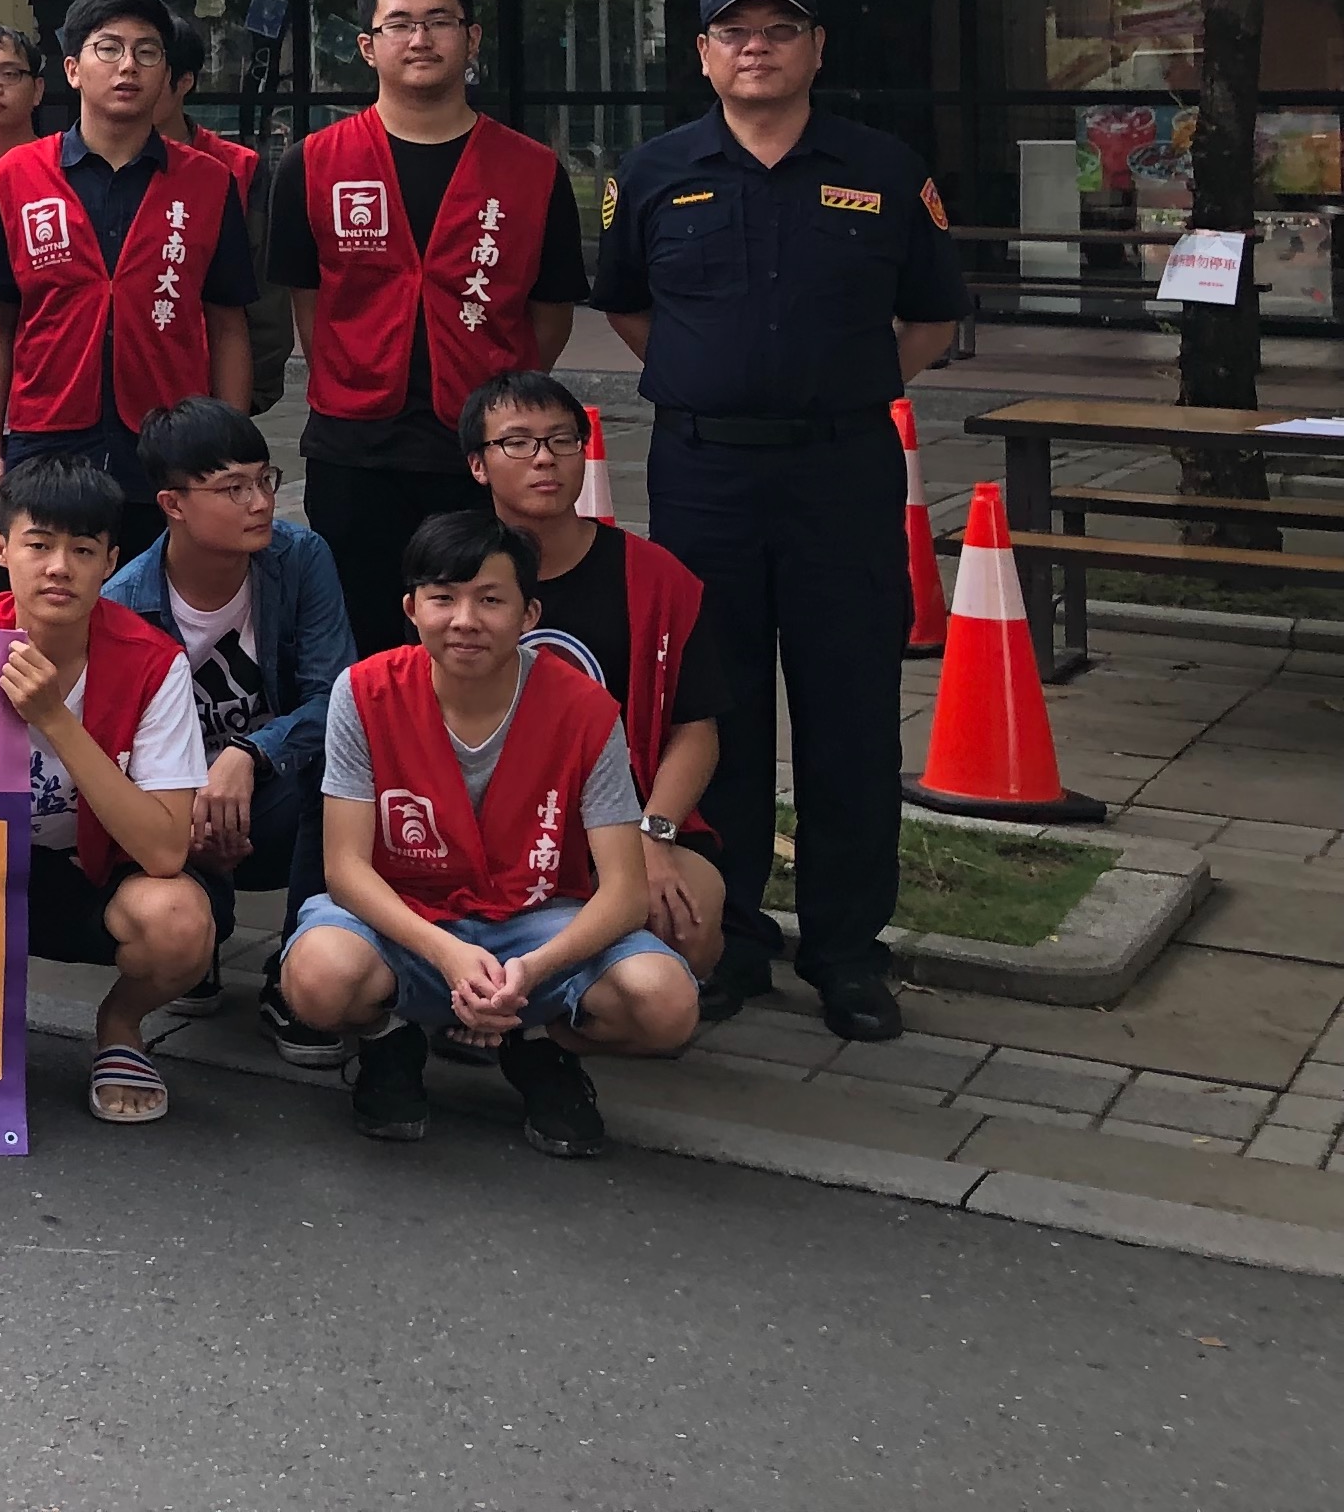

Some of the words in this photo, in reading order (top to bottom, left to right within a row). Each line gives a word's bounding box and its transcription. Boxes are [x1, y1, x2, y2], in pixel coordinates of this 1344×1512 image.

[152, 200, 190, 332] 臺南大學
[459, 197, 506, 332] 臺南大學
